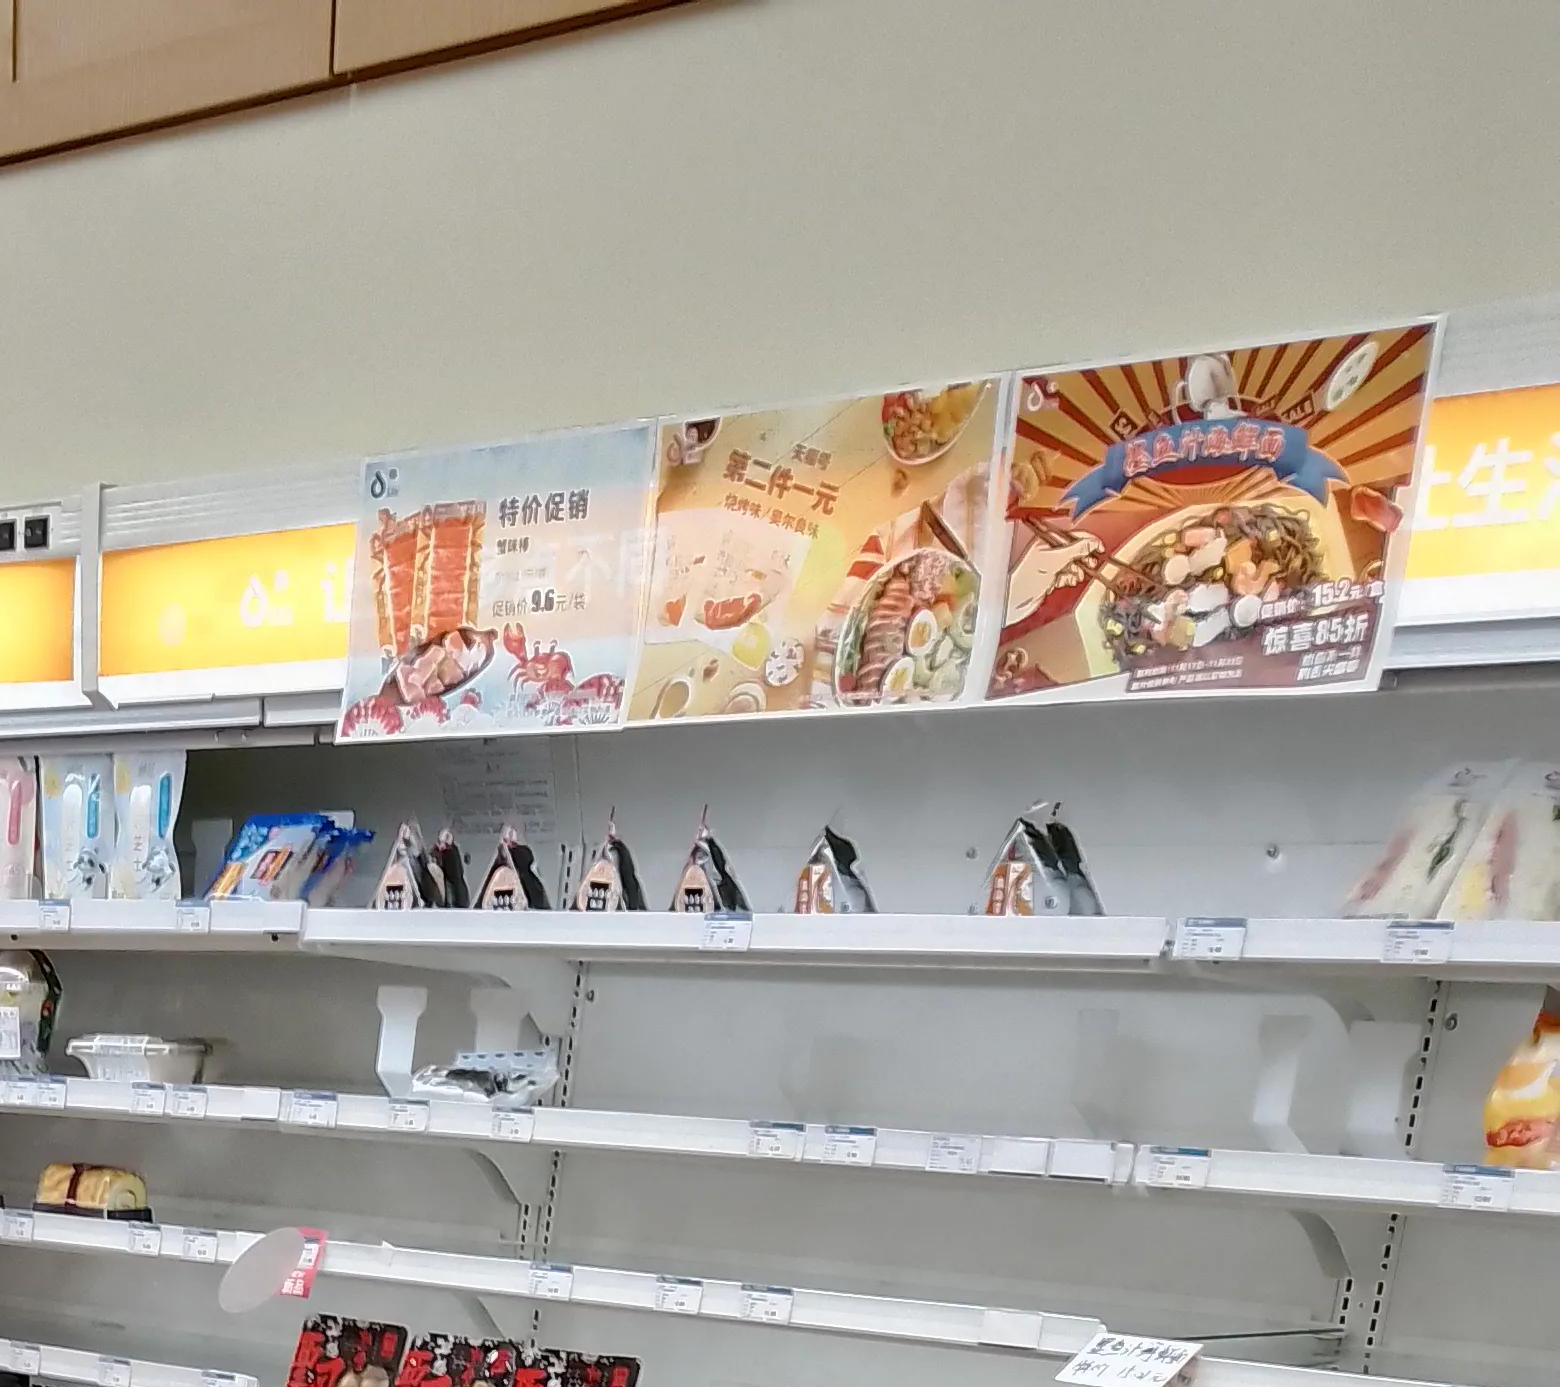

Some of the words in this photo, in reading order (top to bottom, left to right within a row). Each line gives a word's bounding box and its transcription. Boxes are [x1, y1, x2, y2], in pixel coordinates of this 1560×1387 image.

[723, 449, 840, 515] 第二件一元
[498, 489, 590, 528] 特价促销
